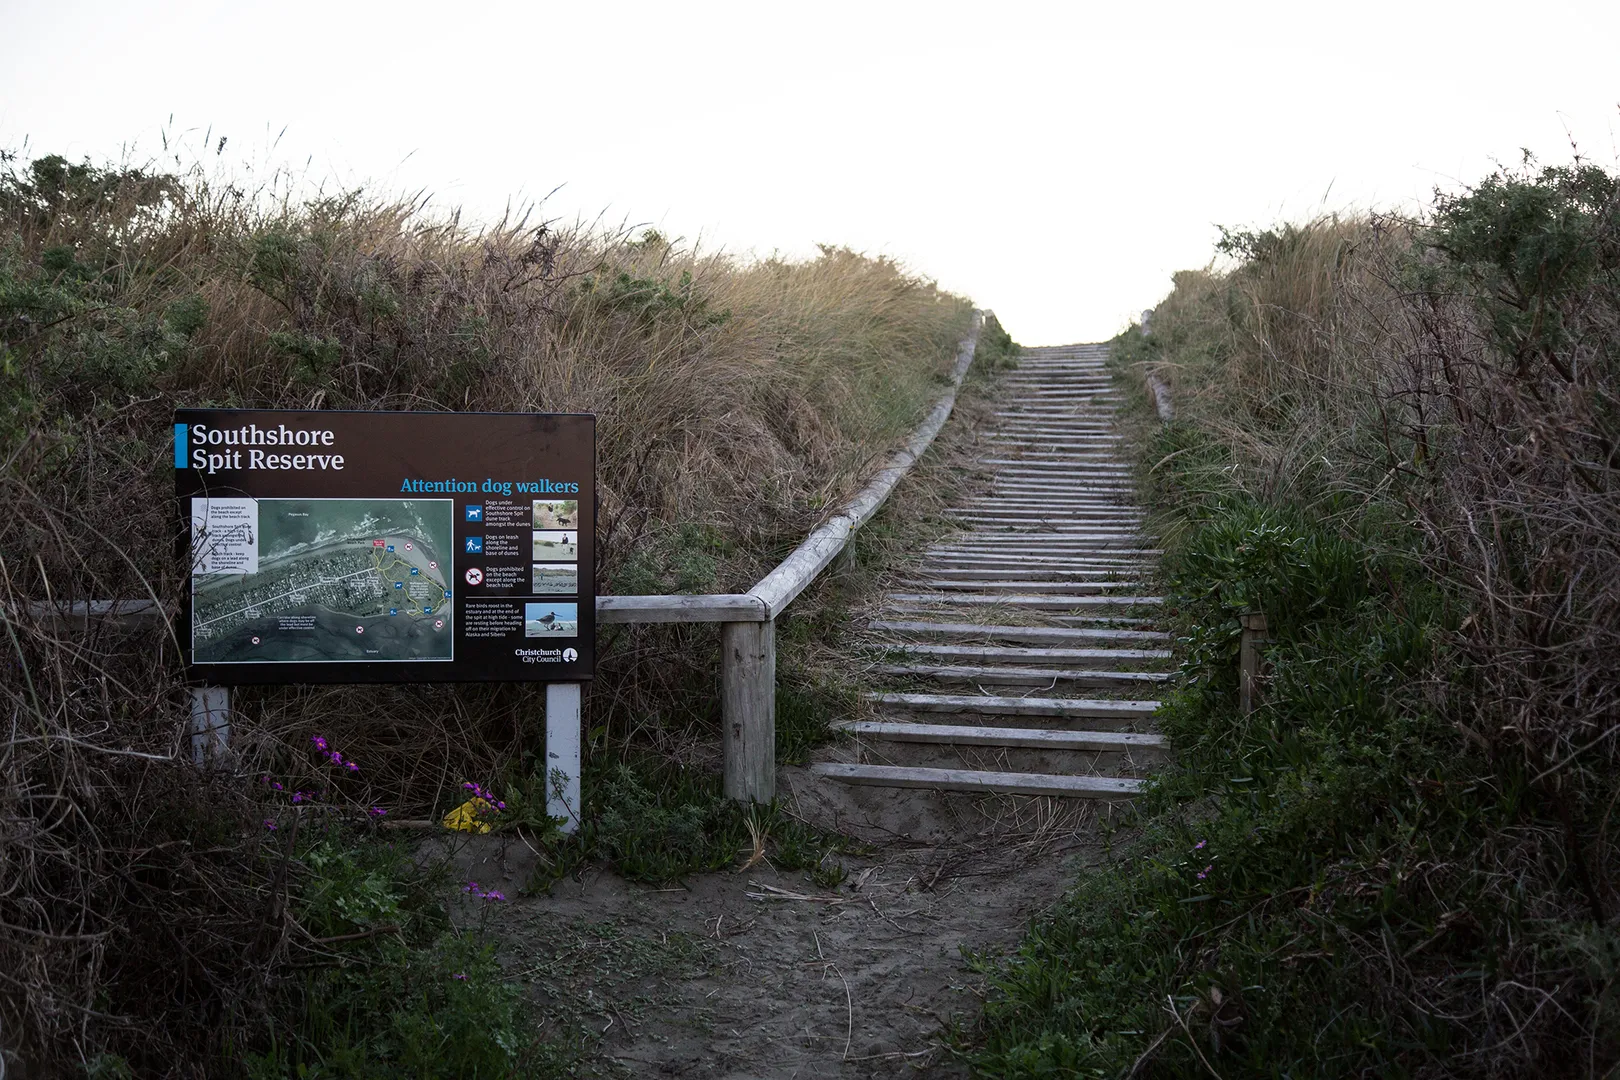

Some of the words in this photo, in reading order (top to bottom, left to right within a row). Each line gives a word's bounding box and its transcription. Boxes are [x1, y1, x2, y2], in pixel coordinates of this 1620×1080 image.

[192, 424, 334, 446] Southshore
[192, 449, 242, 474] Spit
[248, 449, 344, 470] Reserve
[400, 478, 478, 492] Attention
[481, 478, 512, 496] dog
[516, 478, 579, 492] walkers
[522, 656, 536, 664] City
